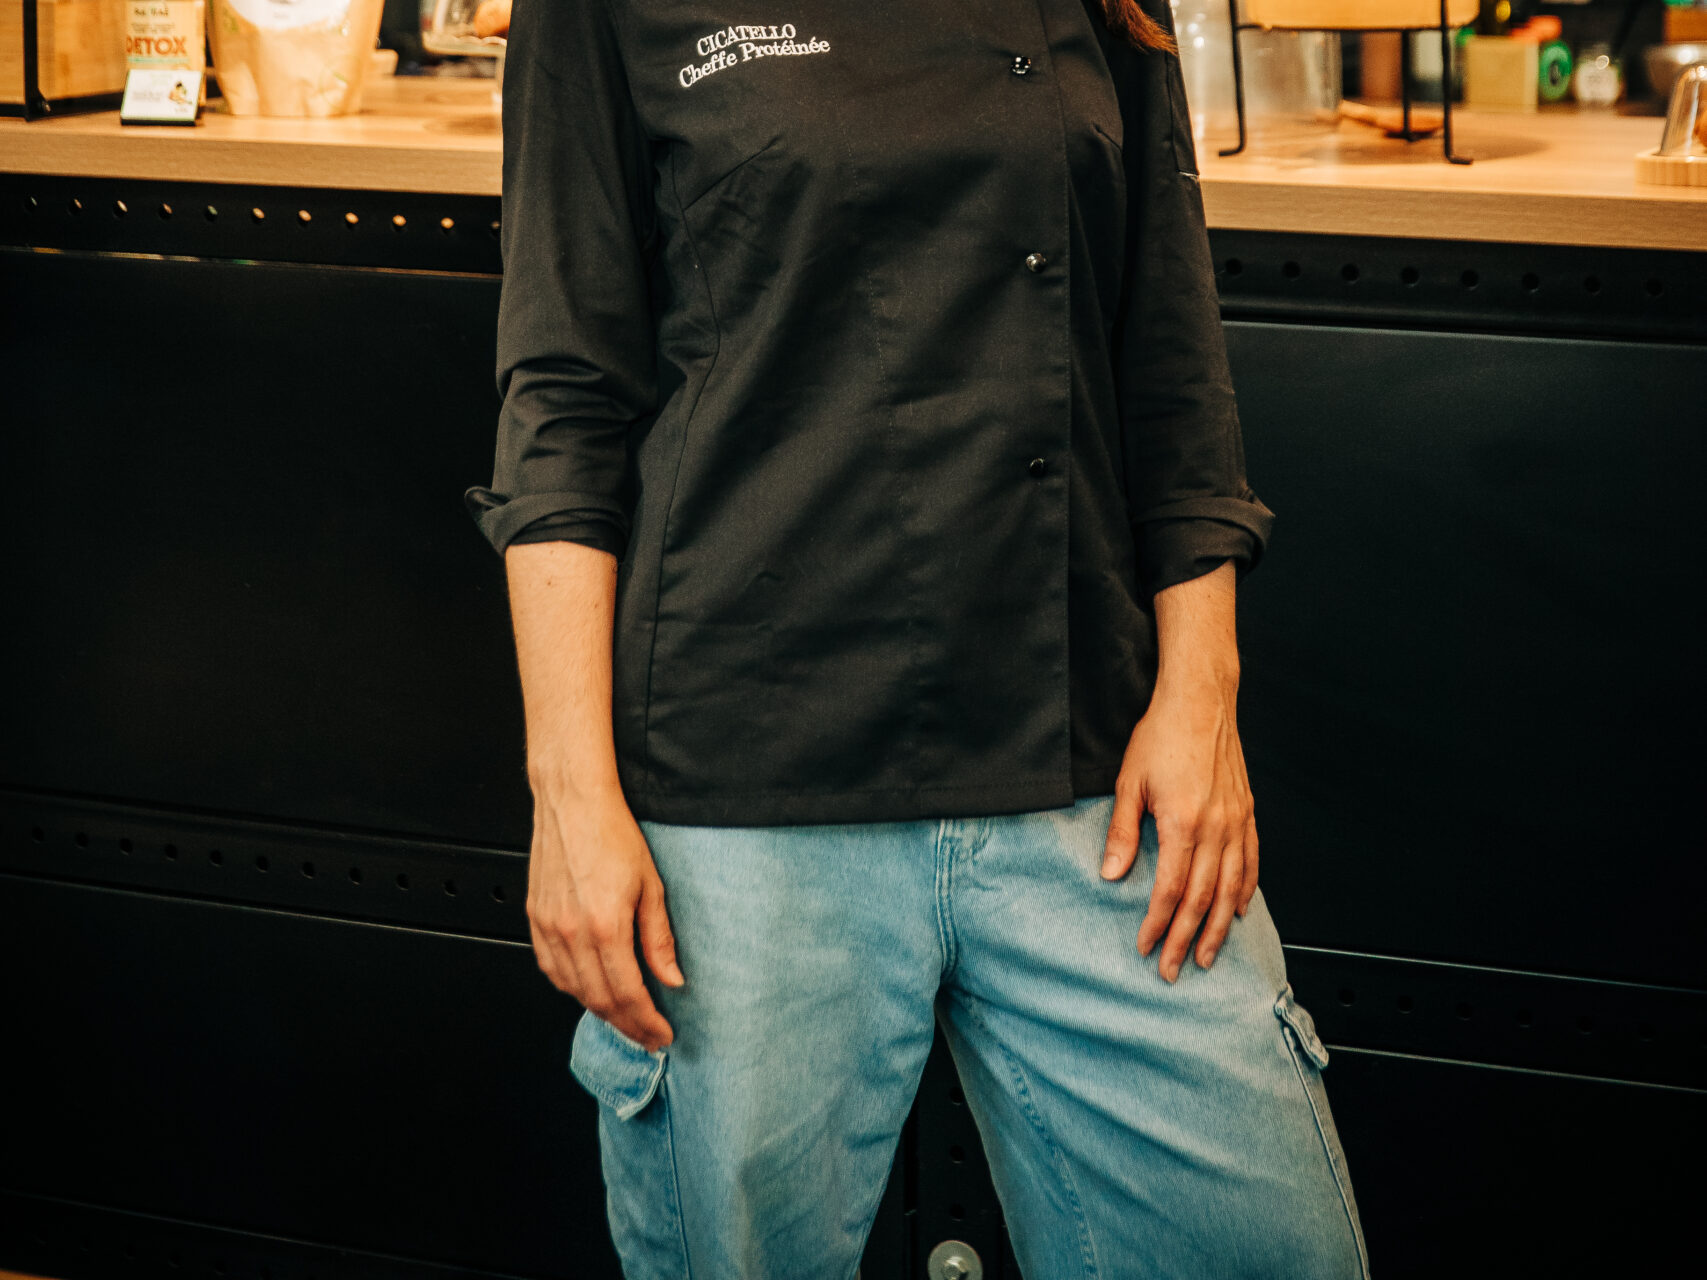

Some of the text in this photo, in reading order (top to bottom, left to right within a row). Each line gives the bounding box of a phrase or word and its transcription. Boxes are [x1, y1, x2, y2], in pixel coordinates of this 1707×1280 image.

[125, 35, 187, 57] DETOX
[697, 23, 796, 56] CICATELLO
[679, 50, 738, 88] Cheffe
